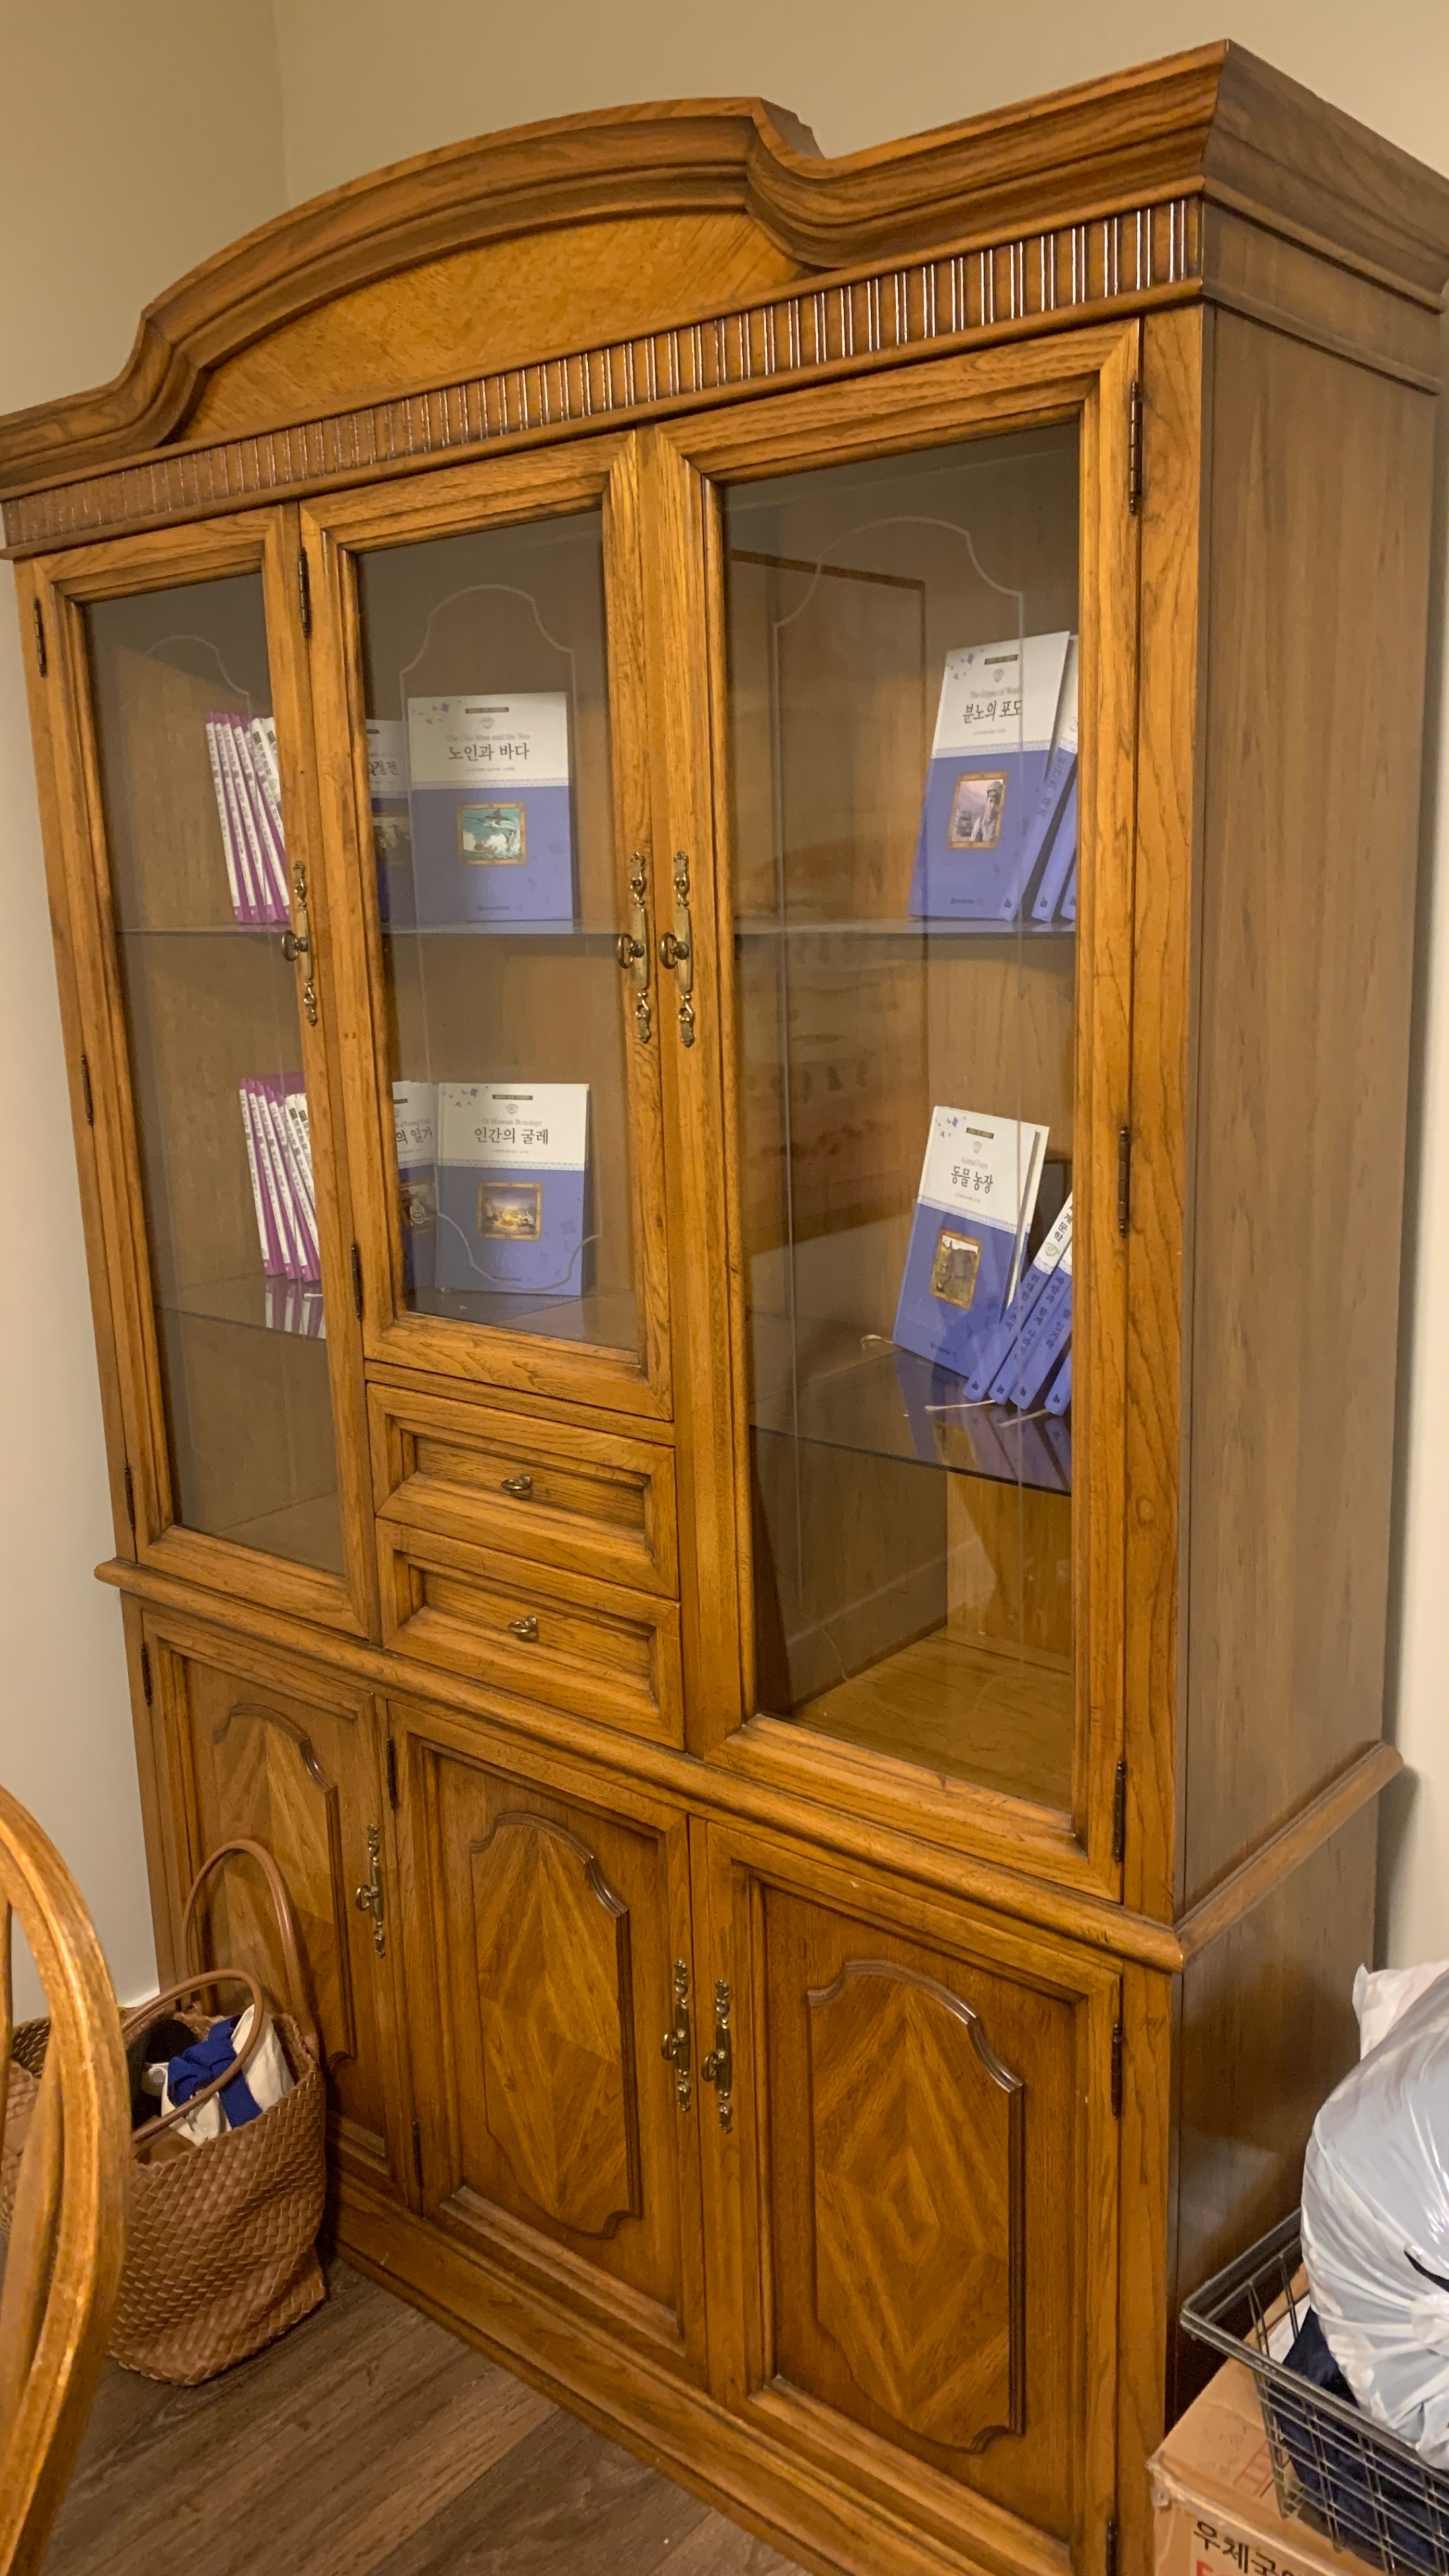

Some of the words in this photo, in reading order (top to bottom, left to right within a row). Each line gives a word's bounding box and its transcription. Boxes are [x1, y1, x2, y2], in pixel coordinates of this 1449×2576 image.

[963, 699, 996, 724] 분노의
[999, 700, 1023, 718] 포도
[447, 744, 494, 761] 노인과
[498, 743, 530, 761] 바다
[410, 1126, 433, 1143] 일기
[474, 1127, 515, 1144] 인간의
[521, 1129, 548, 1145] 굴레
[951, 1165, 971, 1188] 동물
[973, 1171, 994, 1194] 농장
[1053, 1205, 1073, 1242] 계문학
[1193, 2520, 1302, 2576] 우체국
